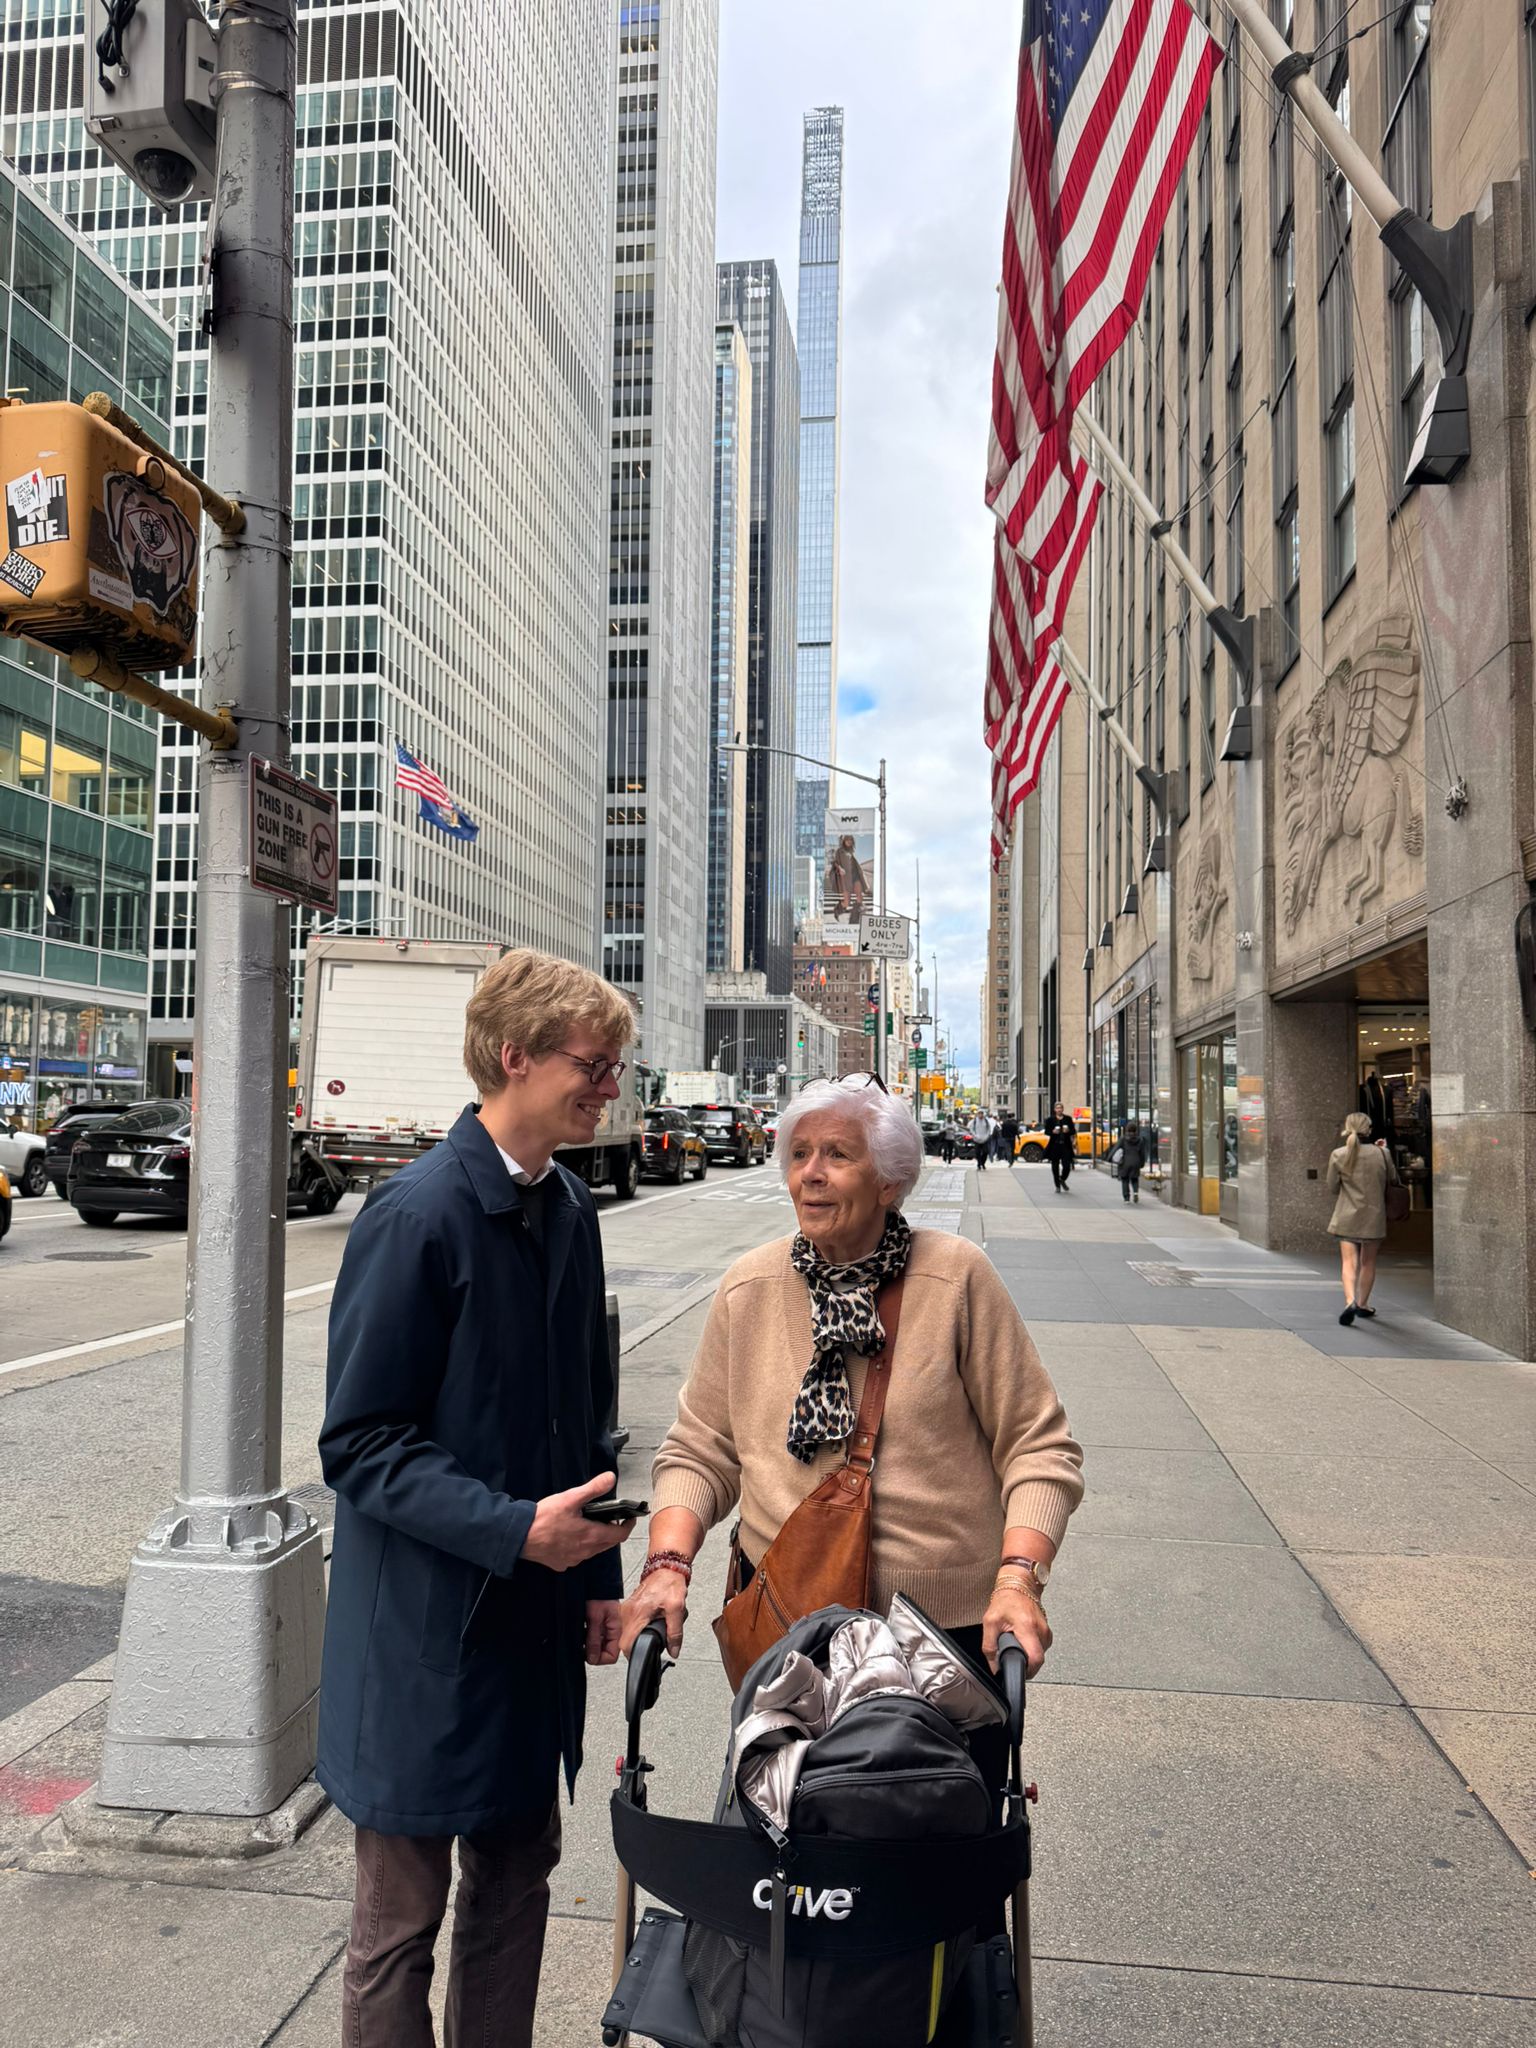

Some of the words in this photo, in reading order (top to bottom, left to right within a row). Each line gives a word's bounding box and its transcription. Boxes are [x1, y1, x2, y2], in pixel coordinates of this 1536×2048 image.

[256, 789, 282, 815] THIS
[284, 804, 294, 821] IS
[296, 808, 304, 826] A
[841, 815, 859, 823] NYC
[256, 812, 280, 838] GUN
[282, 825, 308, 850] FREE
[257, 836, 287, 864] ZONE
[868, 917, 901, 929] BUSES
[871, 929, 897, 940] ONLY
